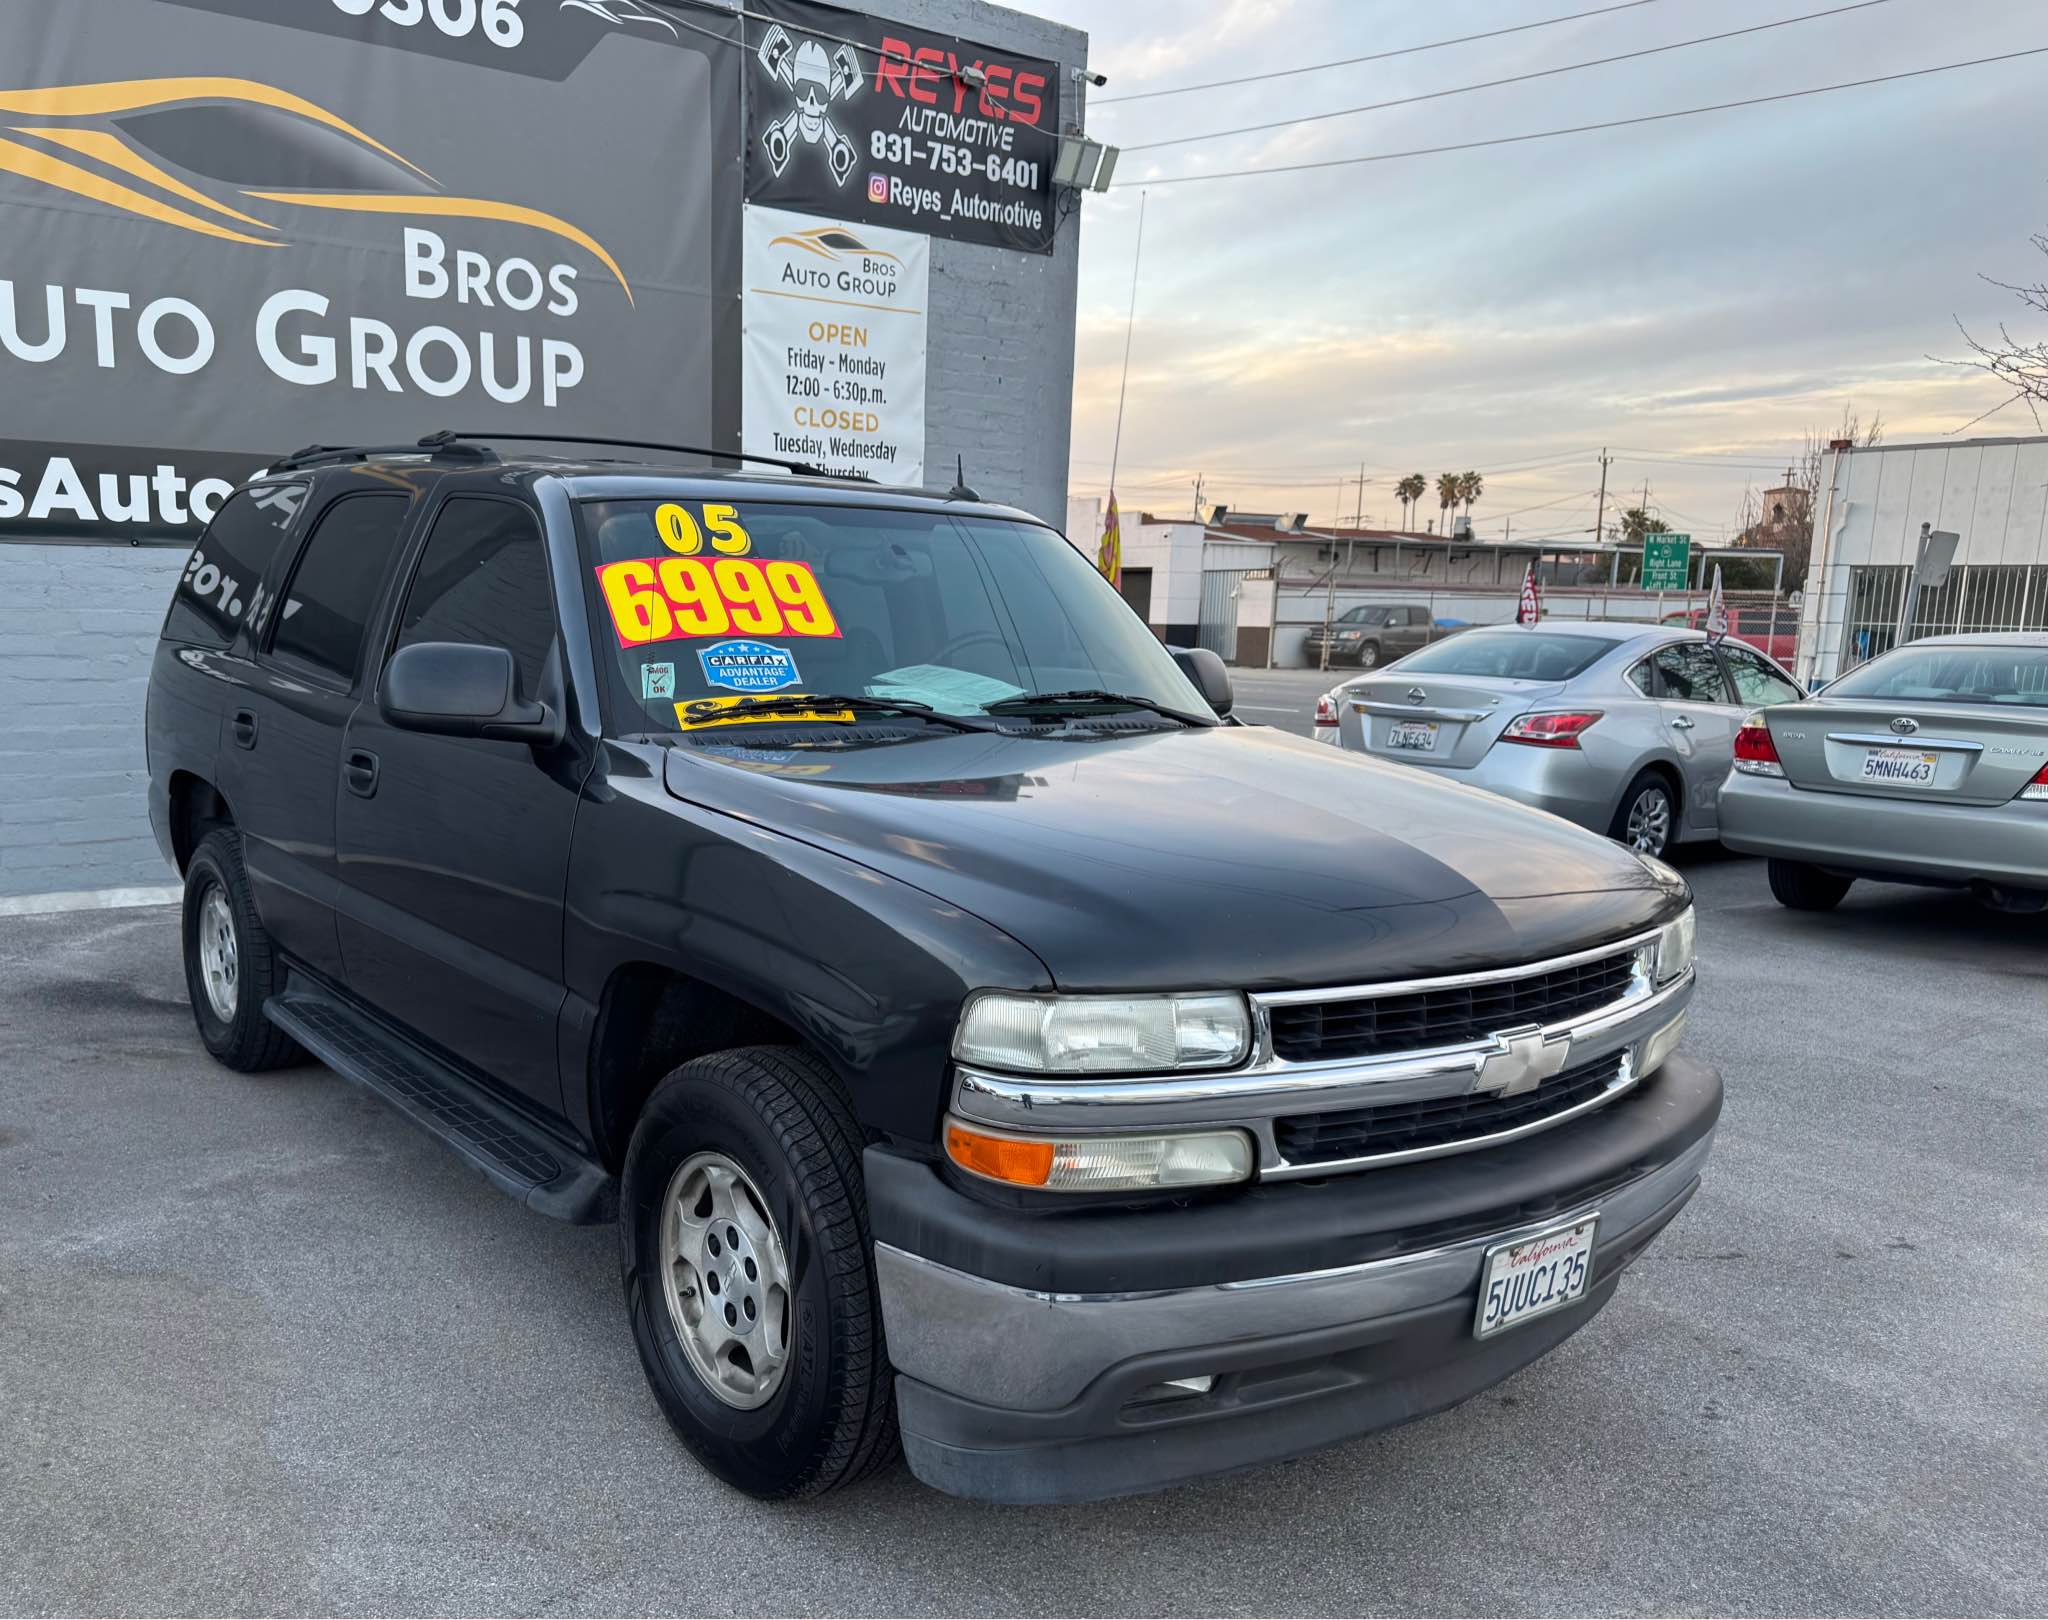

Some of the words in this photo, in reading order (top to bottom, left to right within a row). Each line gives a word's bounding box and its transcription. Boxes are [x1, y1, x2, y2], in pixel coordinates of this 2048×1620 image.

[874, 36, 1046, 126] REYES
[899, 105, 1015, 152] AUTOMOTIVE
[870, 130, 1039, 190] 831-753-6401
[890, 176, 1042, 231] Reyes_Automotive
[403, 227, 579, 317] BROS
[781, 261, 831, 289] AUTO
[836, 271, 897, 299] GROUP
[862, 257, 897, 278] BROS
[255, 288, 585, 408] GROUP
[808, 321, 869, 348] OPEN
[787, 347, 826, 375] Friday
[839, 353, 886, 381] Monday
[786, 374, 821, 398] 12:00
[833, 380, 887, 405] 6:30p.m.
[793, 405, 879, 433] CLOSED
[773, 432, 826, 459] Tuesday,
[829, 436, 897, 463] Wednesday
[655, 503, 752, 556] 05
[1656, 535, 1677, 545] Market
[1650, 559, 1665, 569] Right
[1667, 559, 1682, 568] Lane
[601, 558, 836, 642] 6999
[708, 655, 788, 667] CARFAX
[719, 667, 786, 678] ADVANTAGE
[653, 685, 666, 694] OK
[733, 677, 778, 688] DEALER
[1391, 729, 1432, 747] 7LNE634
[1864, 759, 1931, 781] 5MNH463
[1509, 1236, 1577, 1268] California
[1486, 1249, 1587, 1322] 5UUC135
